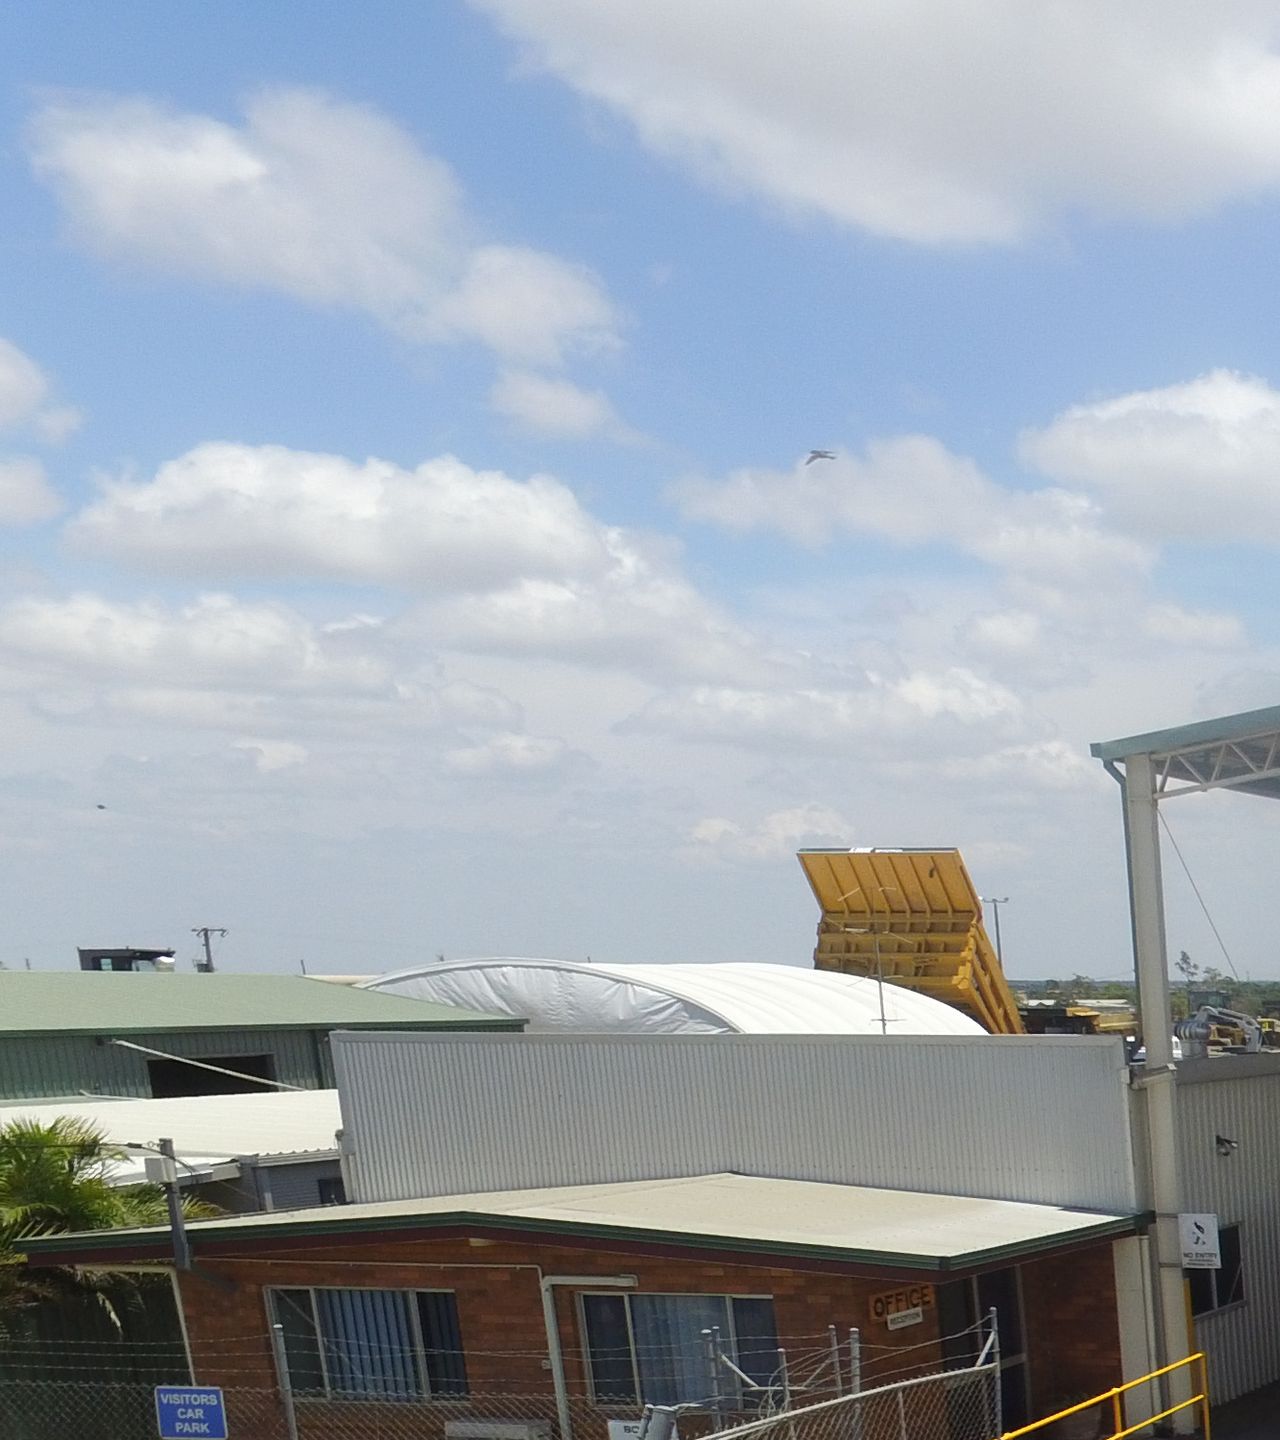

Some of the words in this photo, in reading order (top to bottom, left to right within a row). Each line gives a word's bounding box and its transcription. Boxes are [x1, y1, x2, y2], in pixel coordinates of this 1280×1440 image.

[874, 1285, 931, 1317] OFFICE
[160, 1393, 218, 1406] VISITORS
[177, 1408, 205, 1419] CAR
[175, 1422, 210, 1433] PARK
